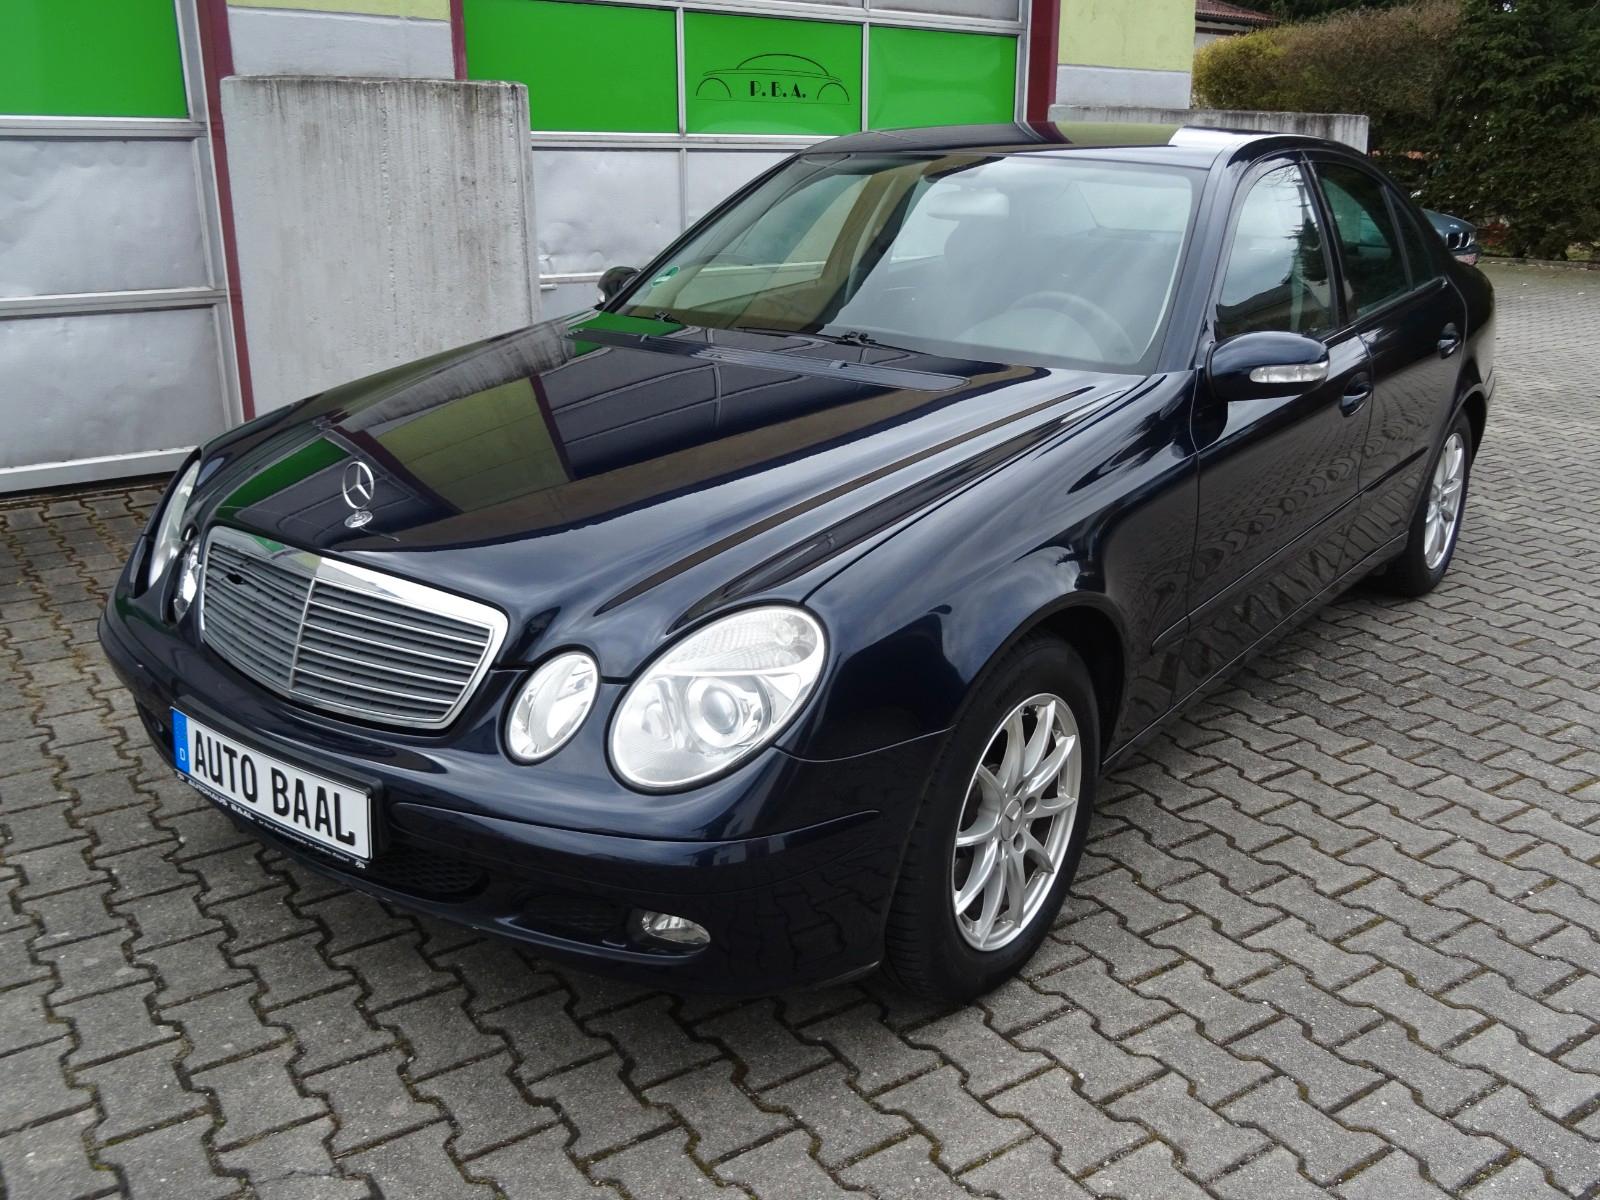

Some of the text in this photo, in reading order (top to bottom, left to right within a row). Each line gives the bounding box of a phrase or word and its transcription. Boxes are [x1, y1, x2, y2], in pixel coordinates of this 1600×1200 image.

[179, 747, 186, 761] D
[195, 729, 258, 803] AUTO
[271, 766, 356, 846] BAAL
